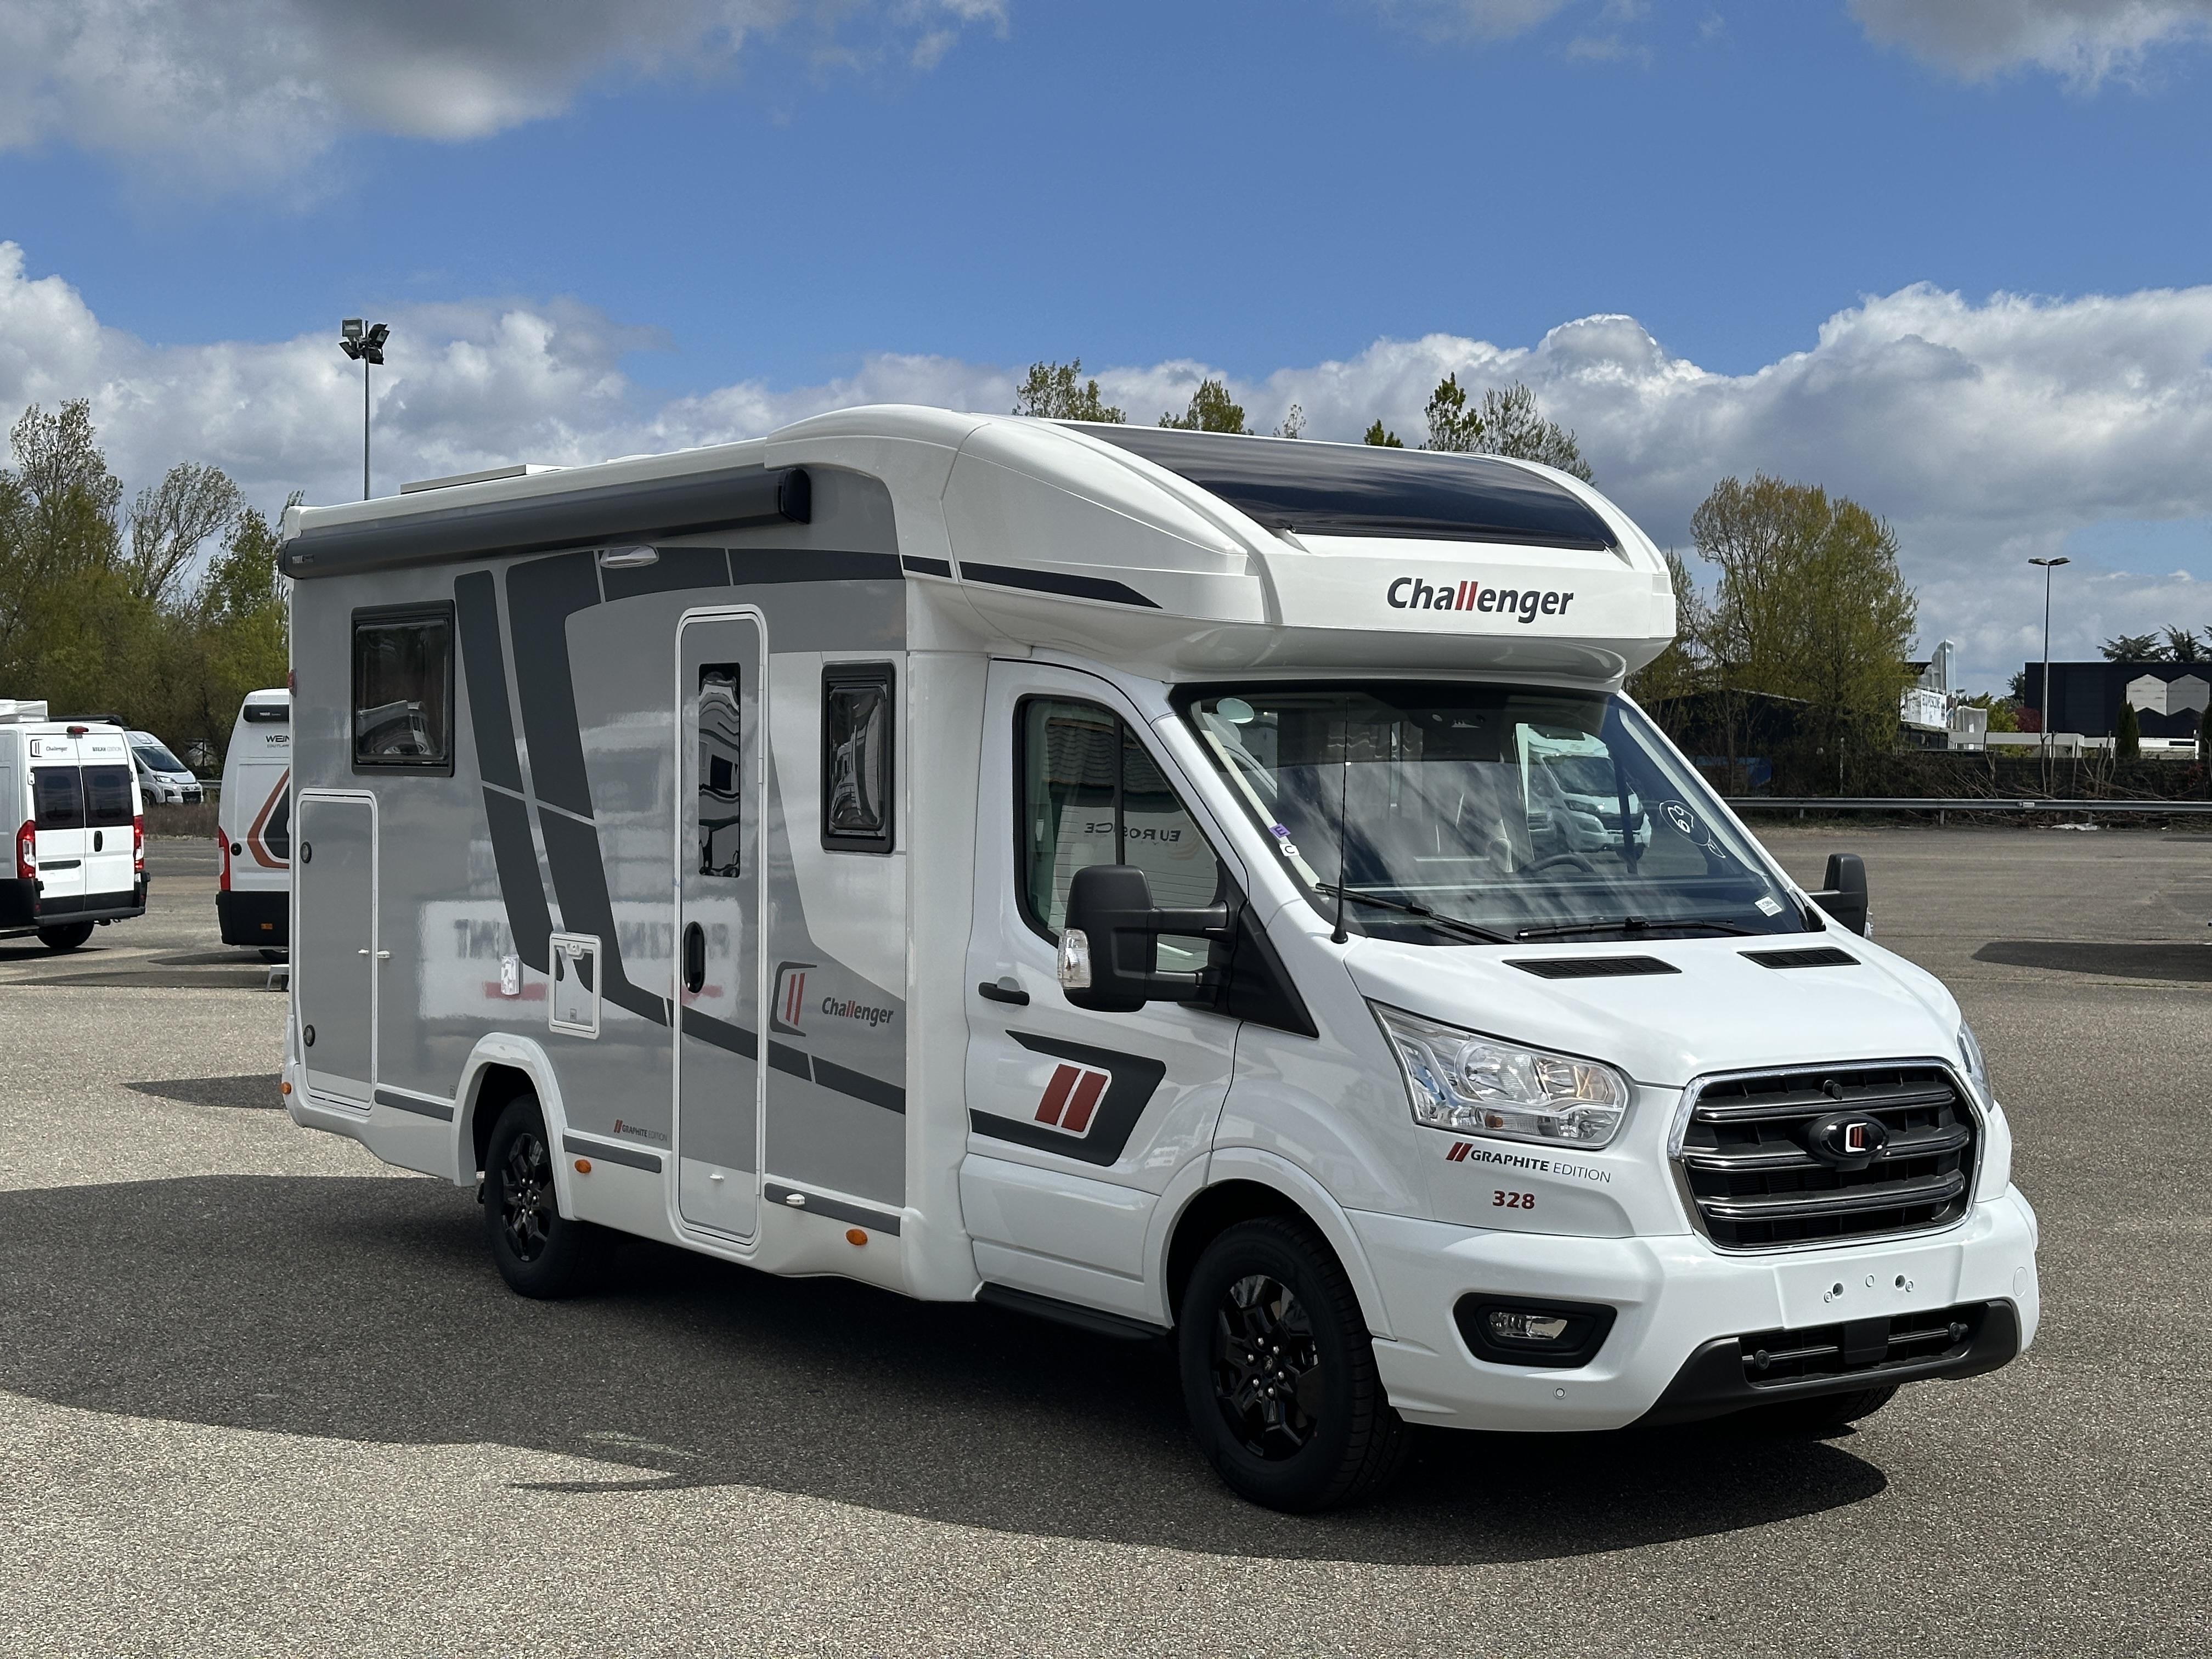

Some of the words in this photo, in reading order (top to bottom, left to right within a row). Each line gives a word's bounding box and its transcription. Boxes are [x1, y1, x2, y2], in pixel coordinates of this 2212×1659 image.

[1387, 577, 1574, 624] Challenger
[822, 997, 894, 1027] Challenger
[622, 1124, 647, 1137] GRAPHITE
[648, 1130, 667, 1142] EDITION
[1470, 1150, 1550, 1172] GRAPHITE
[1553, 1163, 1611, 1183] EDITION
[1492, 1190, 1535, 1209] 328
